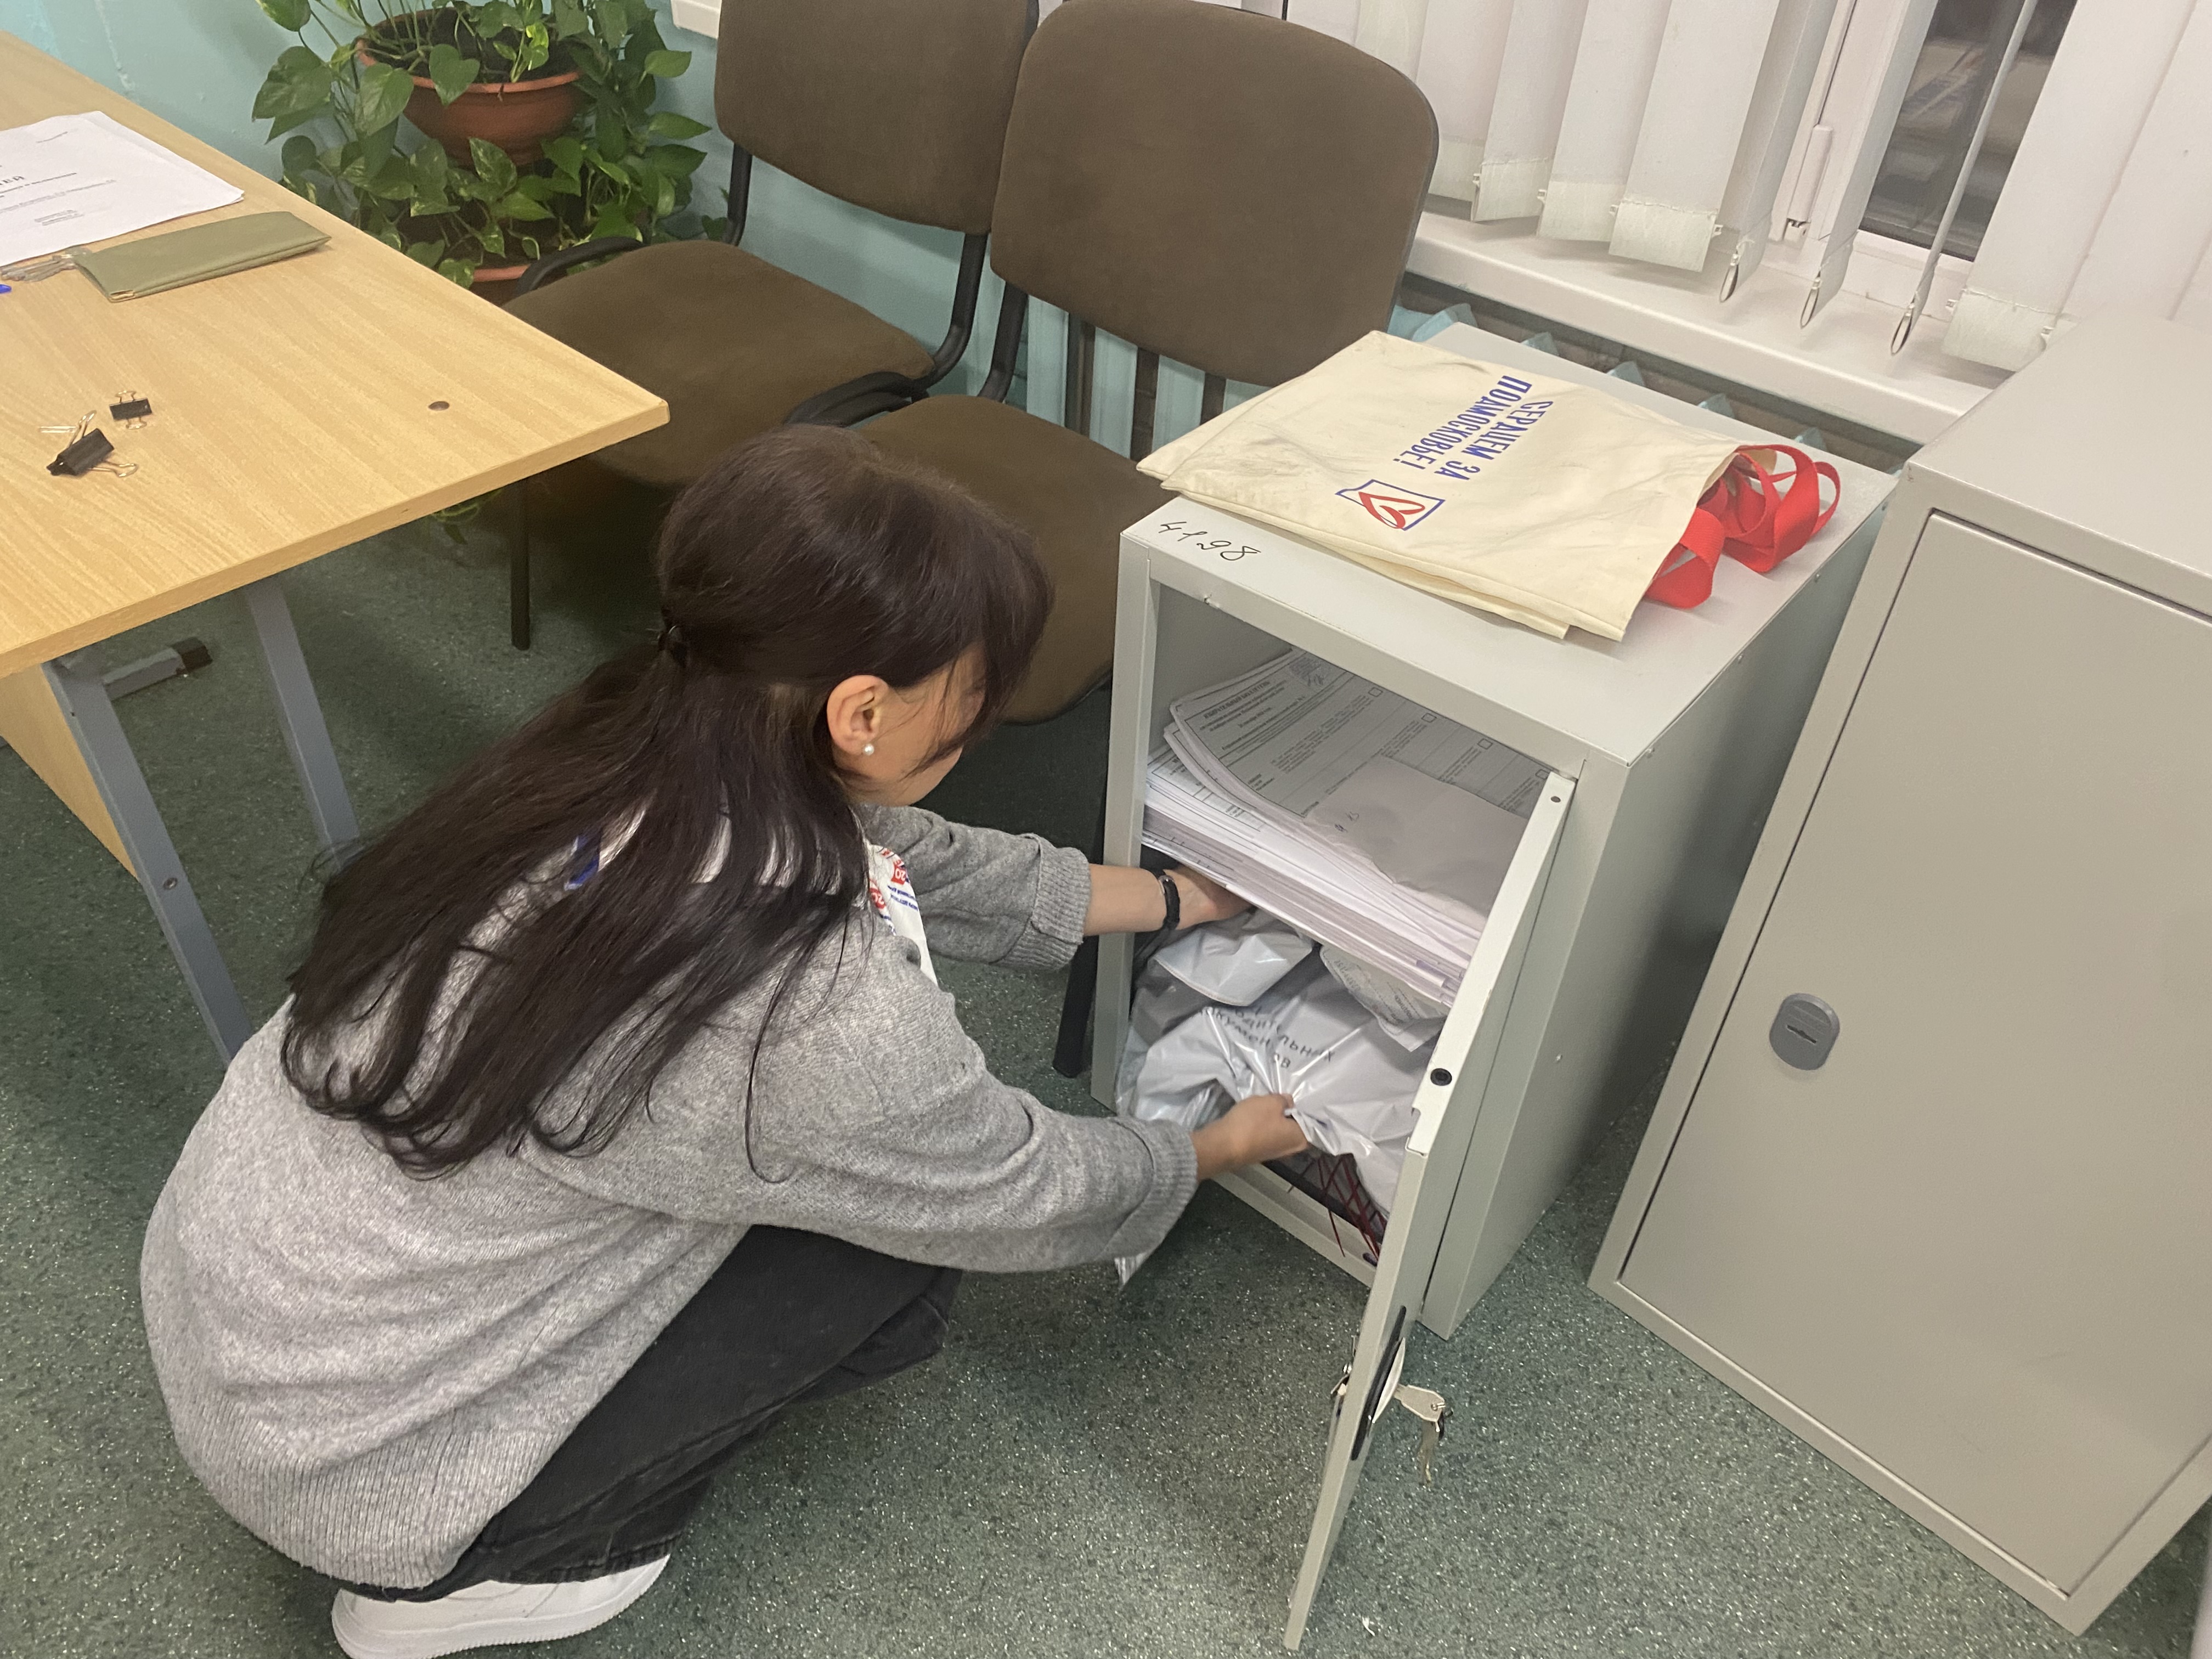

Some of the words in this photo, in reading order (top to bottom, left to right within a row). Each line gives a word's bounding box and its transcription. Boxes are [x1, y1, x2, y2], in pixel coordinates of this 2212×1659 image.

[1393, 376, 1532, 470] ПОДМОСКОВЬЕ!
[1461, 401, 1553, 460] СЕРДЦЕМ
[1434, 461, 1480, 480] ЗА
[1159, 521, 1261, 561] 4198
